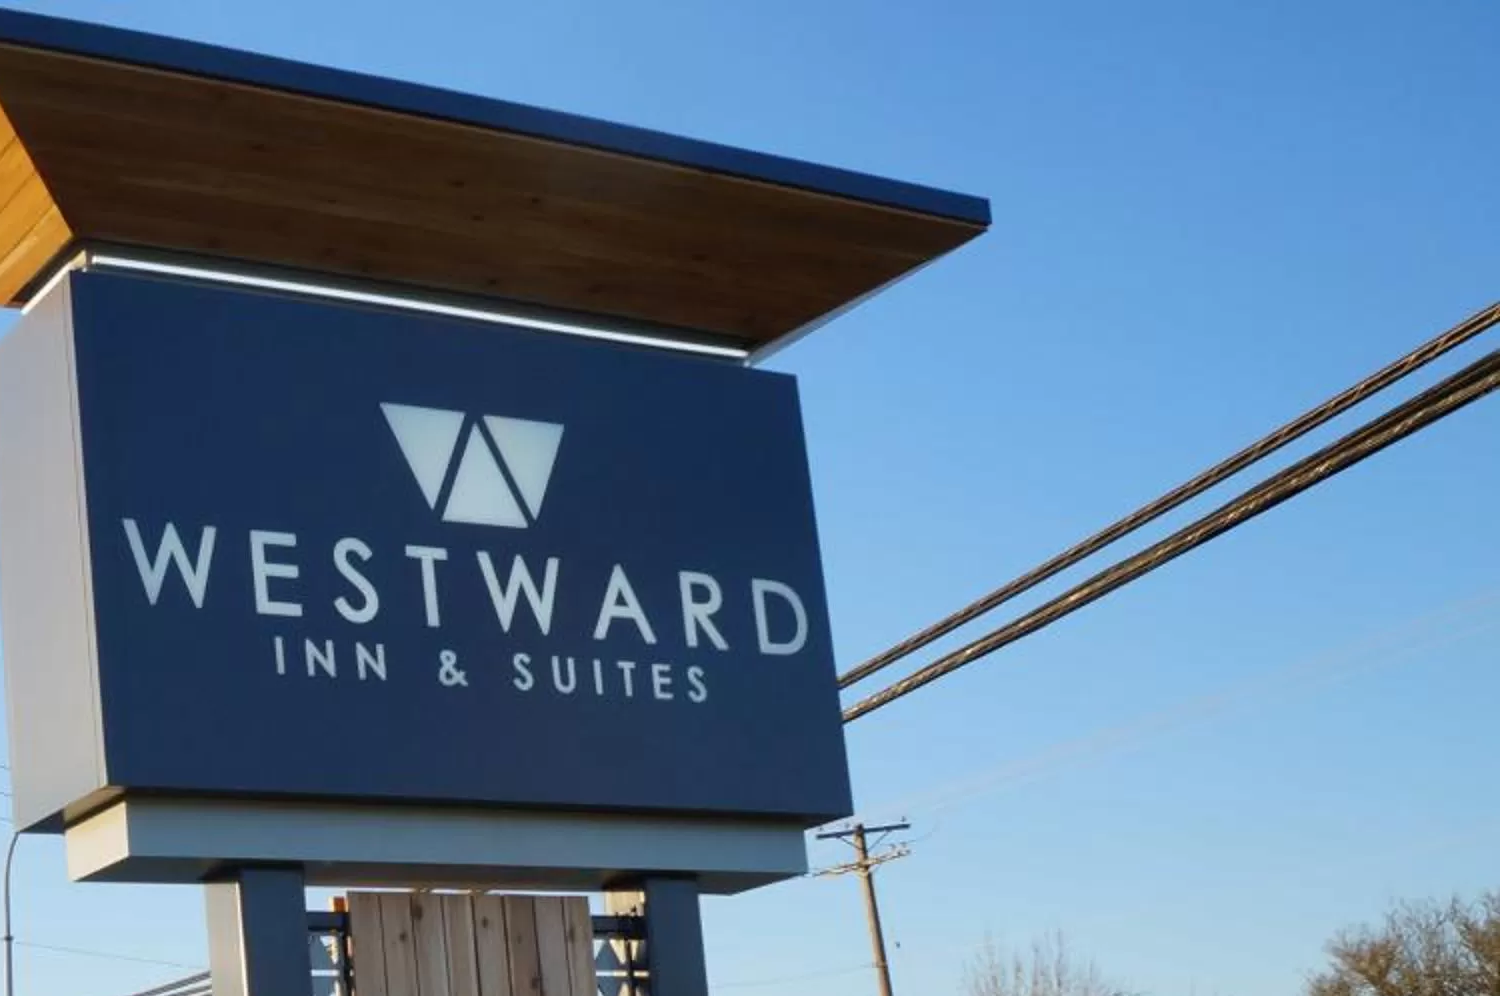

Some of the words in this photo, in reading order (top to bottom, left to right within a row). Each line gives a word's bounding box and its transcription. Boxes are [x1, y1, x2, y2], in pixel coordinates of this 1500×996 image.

[123, 518, 809, 656] WESTWARD
[275, 635, 387, 682] INN
[438, 649, 469, 687] &
[512, 652, 708, 704] SUITES
